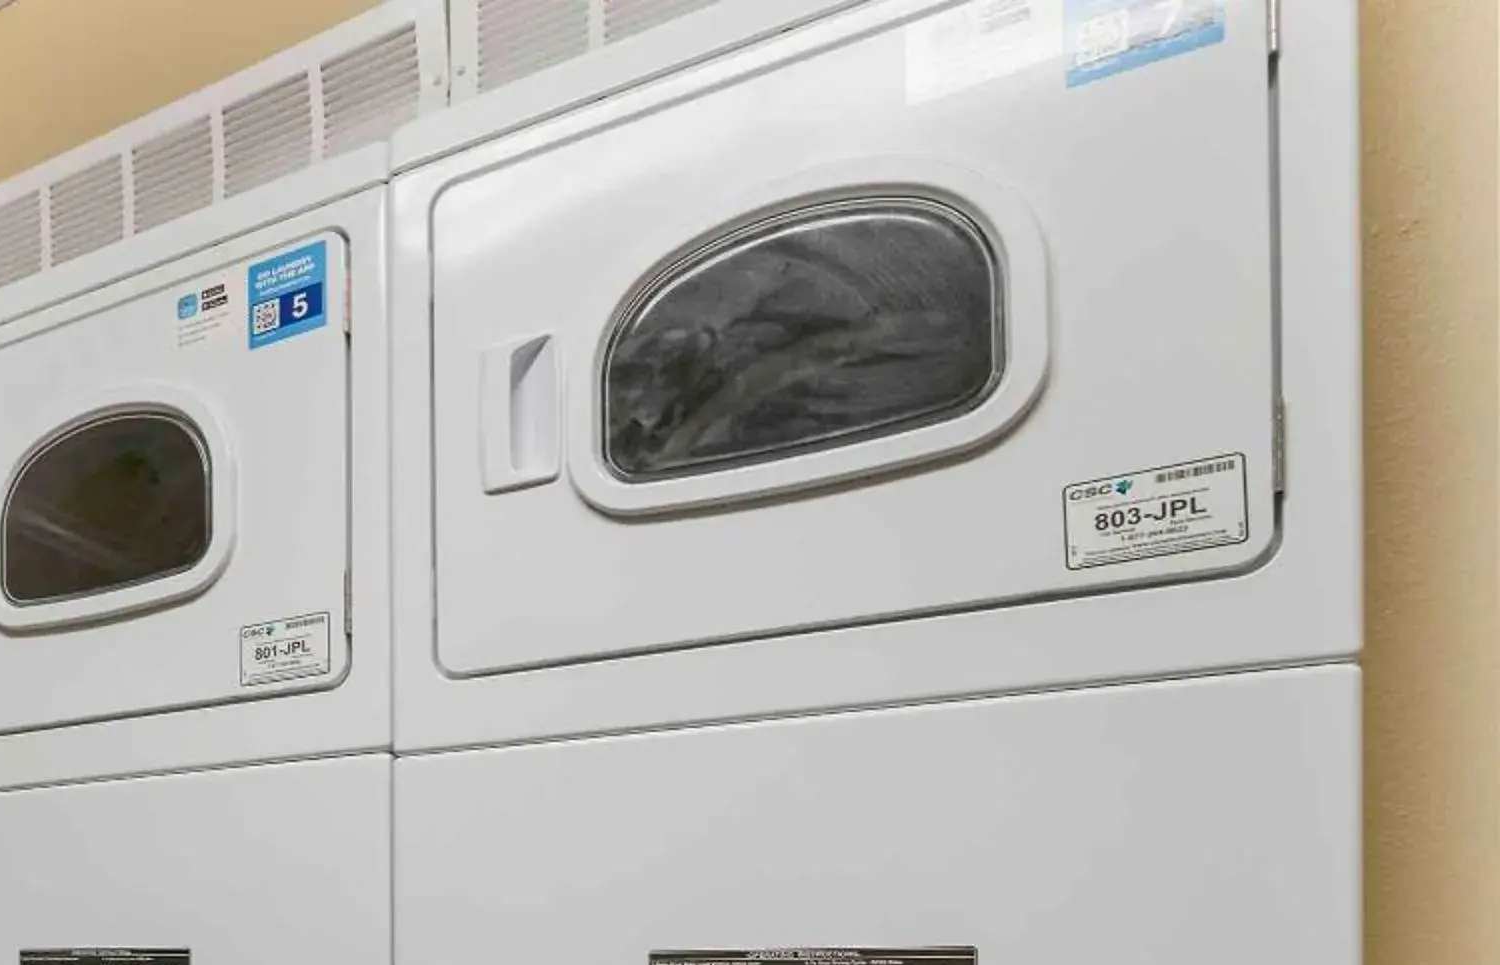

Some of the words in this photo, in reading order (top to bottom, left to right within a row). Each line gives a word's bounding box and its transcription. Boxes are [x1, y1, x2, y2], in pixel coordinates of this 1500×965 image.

[291, 293, 308, 319] 5
[1069, 483, 1113, 501] CSC
[1094, 496, 1208, 531] 803-JPL
[254, 640, 311, 660] 801-JPL
